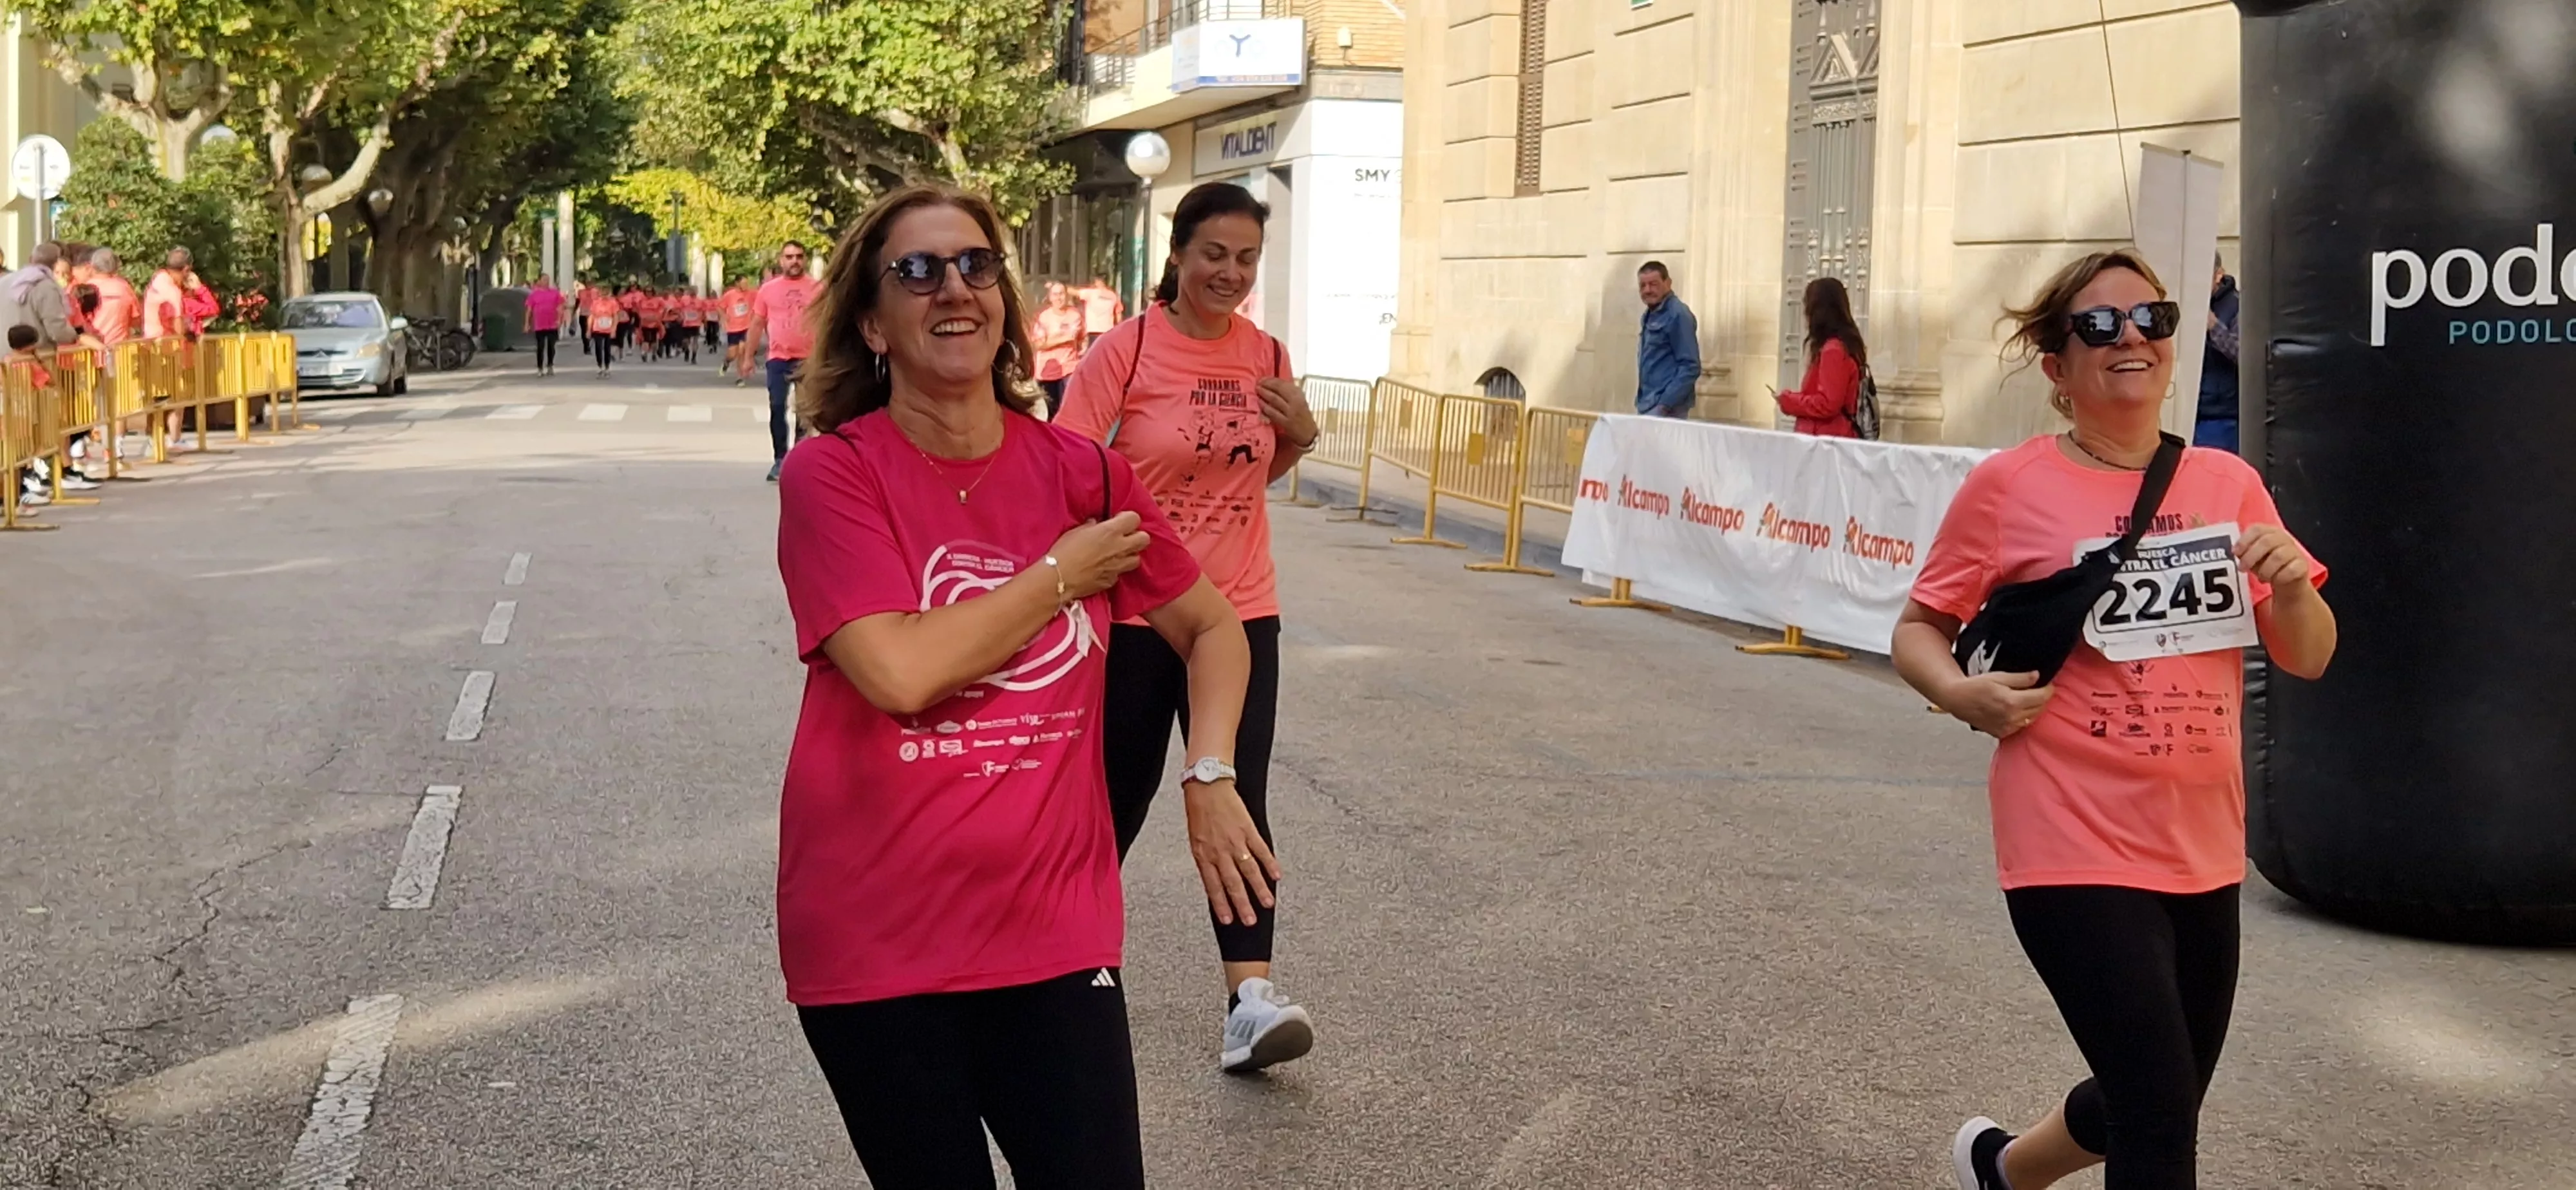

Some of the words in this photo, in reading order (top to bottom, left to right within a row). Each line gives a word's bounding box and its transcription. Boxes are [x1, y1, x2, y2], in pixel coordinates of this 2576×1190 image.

[1220, 121, 1277, 160] VITALDENT
[2371, 223, 2576, 346] pod
[1618, 474, 1670, 520] Alcampo
[1680, 486, 1745, 536] Alcampo
[1756, 502, 1831, 552] Alcampo
[1843, 515, 1915, 570] Alcampo
[2115, 513, 2184, 534] COAMOS
[2152, 559, 2169, 571] EL
[2170, 547, 2228, 567] CÁNCER
[2099, 568, 2235, 625] 2245
